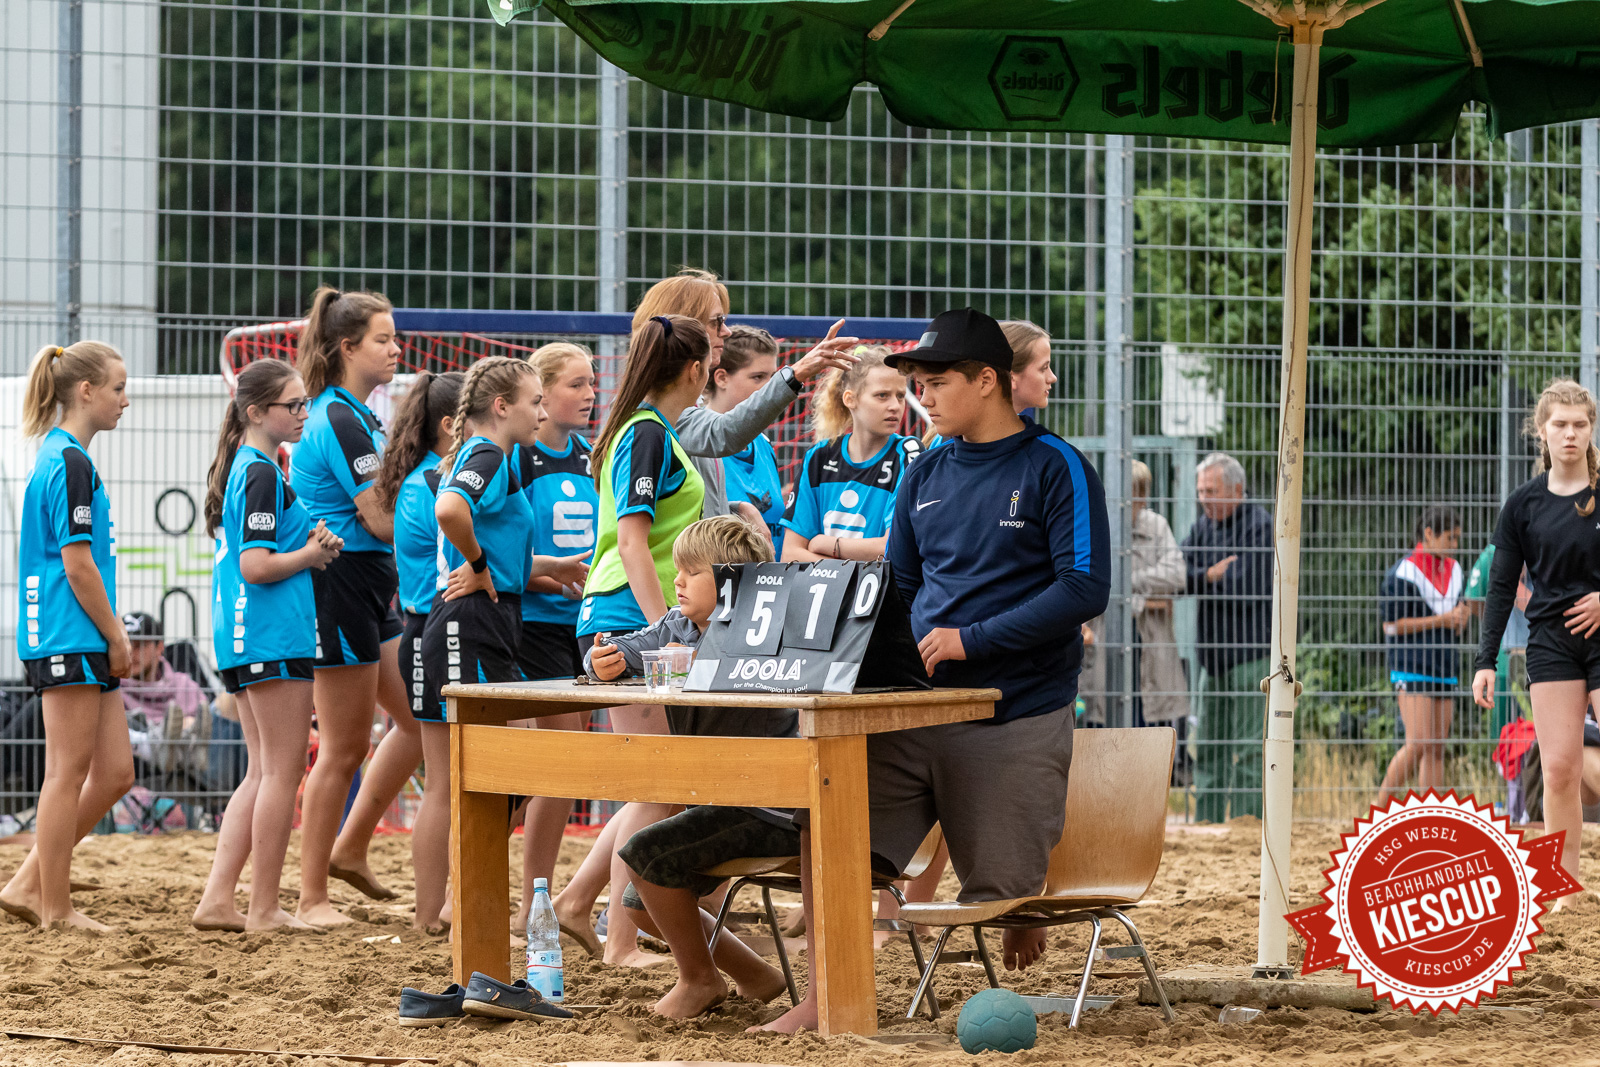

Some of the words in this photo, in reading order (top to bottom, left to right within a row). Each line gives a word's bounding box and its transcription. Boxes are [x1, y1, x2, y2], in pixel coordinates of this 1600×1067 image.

[877, 461, 893, 484] 5
[999, 519, 1025, 528] innogy
[809, 568, 837, 579] JOOLA
[756, 575, 783, 585] JOOLA
[745, 590, 777, 646] 5
[804, 583, 828, 640] 1
[854, 573, 879, 615] 0
[728, 659, 801, 681] JOOLA
[755, 682, 785, 693] Champion
